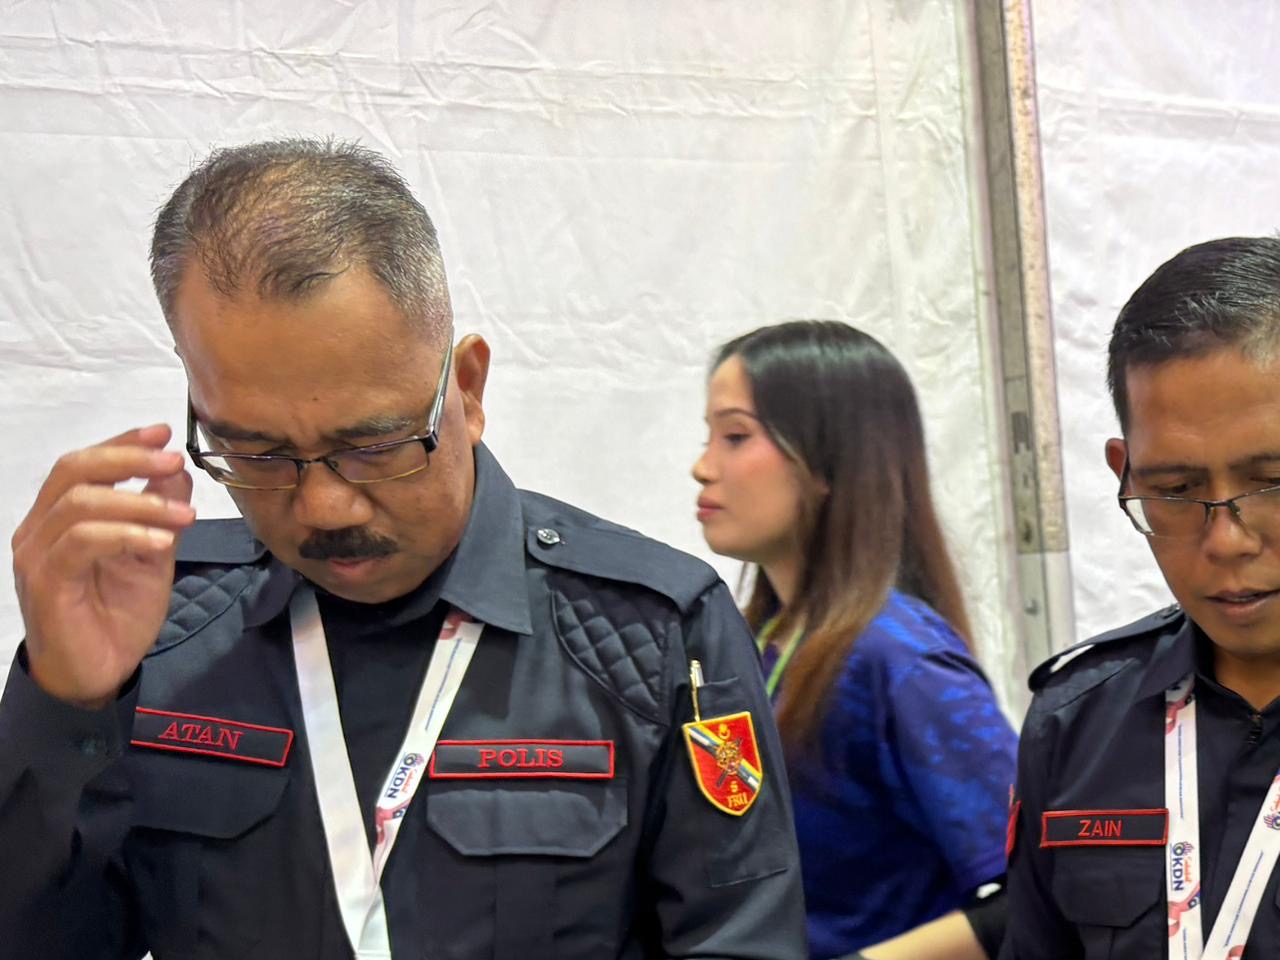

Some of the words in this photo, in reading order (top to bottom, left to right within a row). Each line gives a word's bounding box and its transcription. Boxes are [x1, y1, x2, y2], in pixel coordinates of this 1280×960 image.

[158, 721, 245, 750] ATAN
[478, 748, 564, 768] POLIS
[1078, 819, 1123, 838] ZAIN
